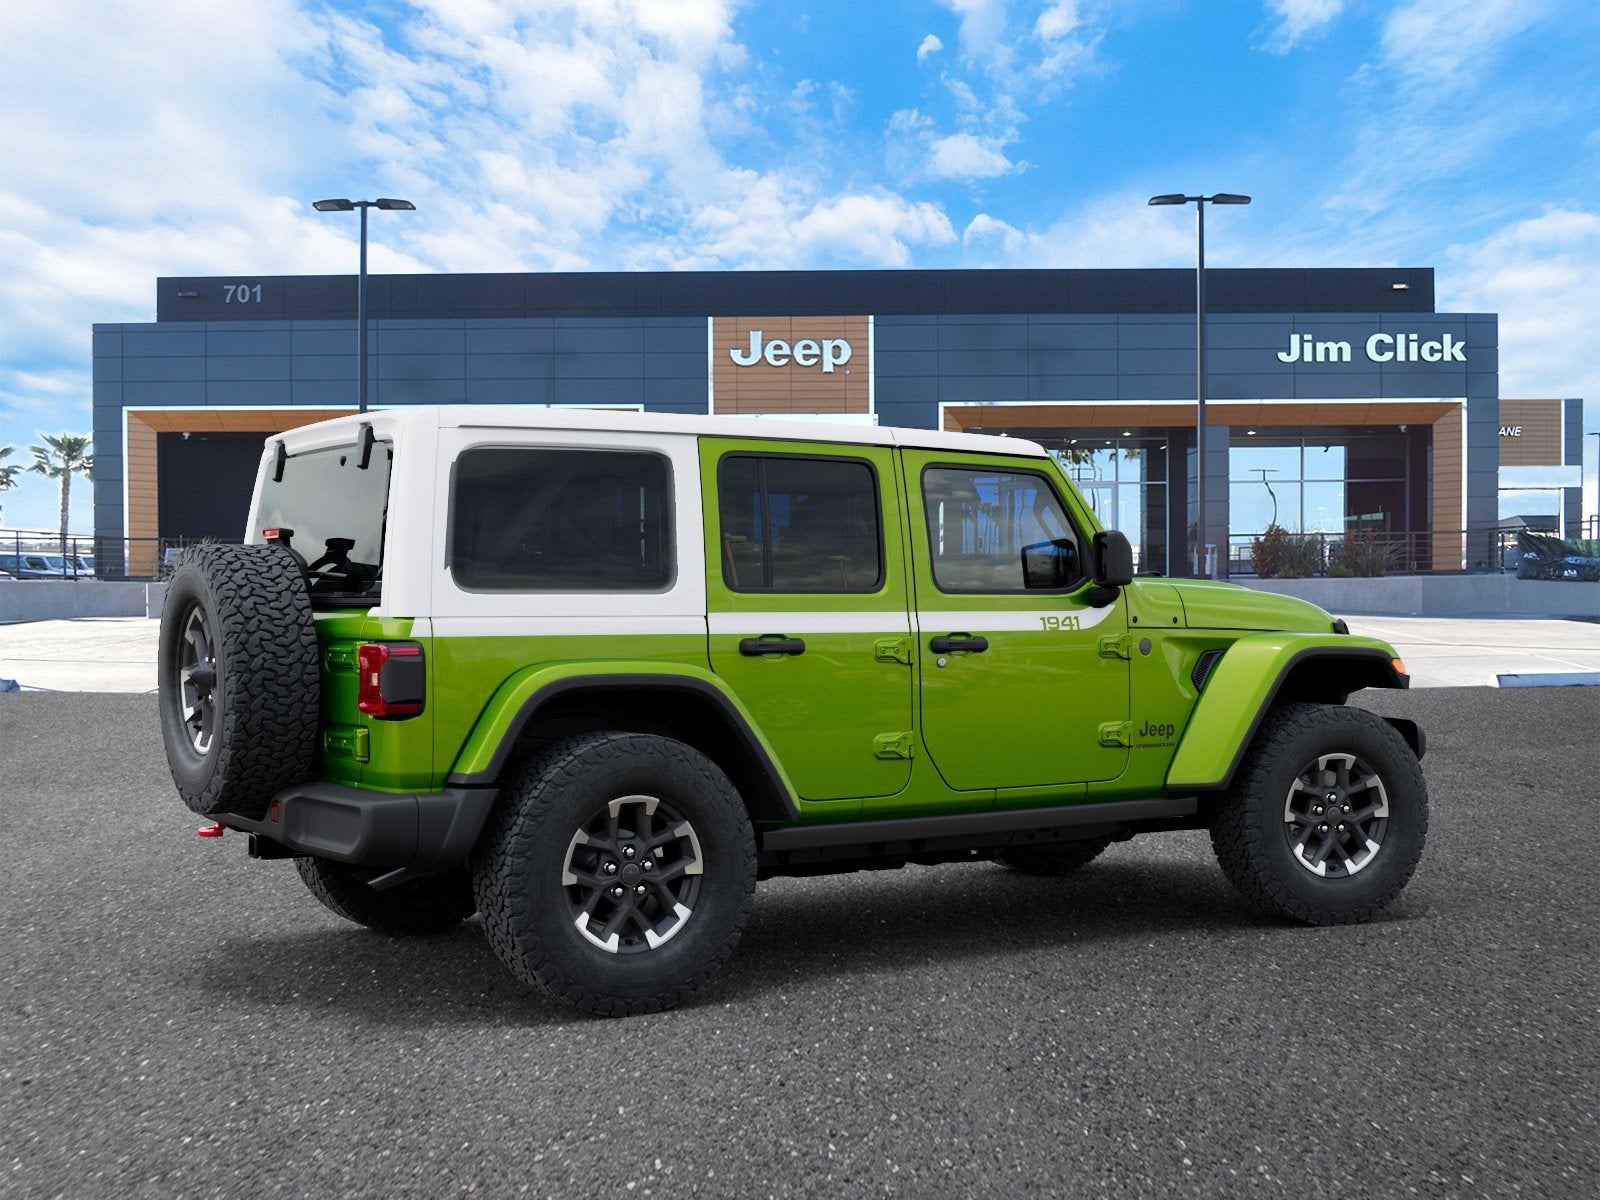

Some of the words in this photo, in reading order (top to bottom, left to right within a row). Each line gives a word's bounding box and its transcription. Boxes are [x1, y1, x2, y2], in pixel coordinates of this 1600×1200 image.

[223, 284, 262, 303] 701
[730, 330, 852, 373] Jeep
[1277, 333, 1352, 362] Jim
[1365, 333, 1467, 362] Click
[1039, 615, 1081, 631] 1941
[1138, 720, 1175, 740] Jeep
